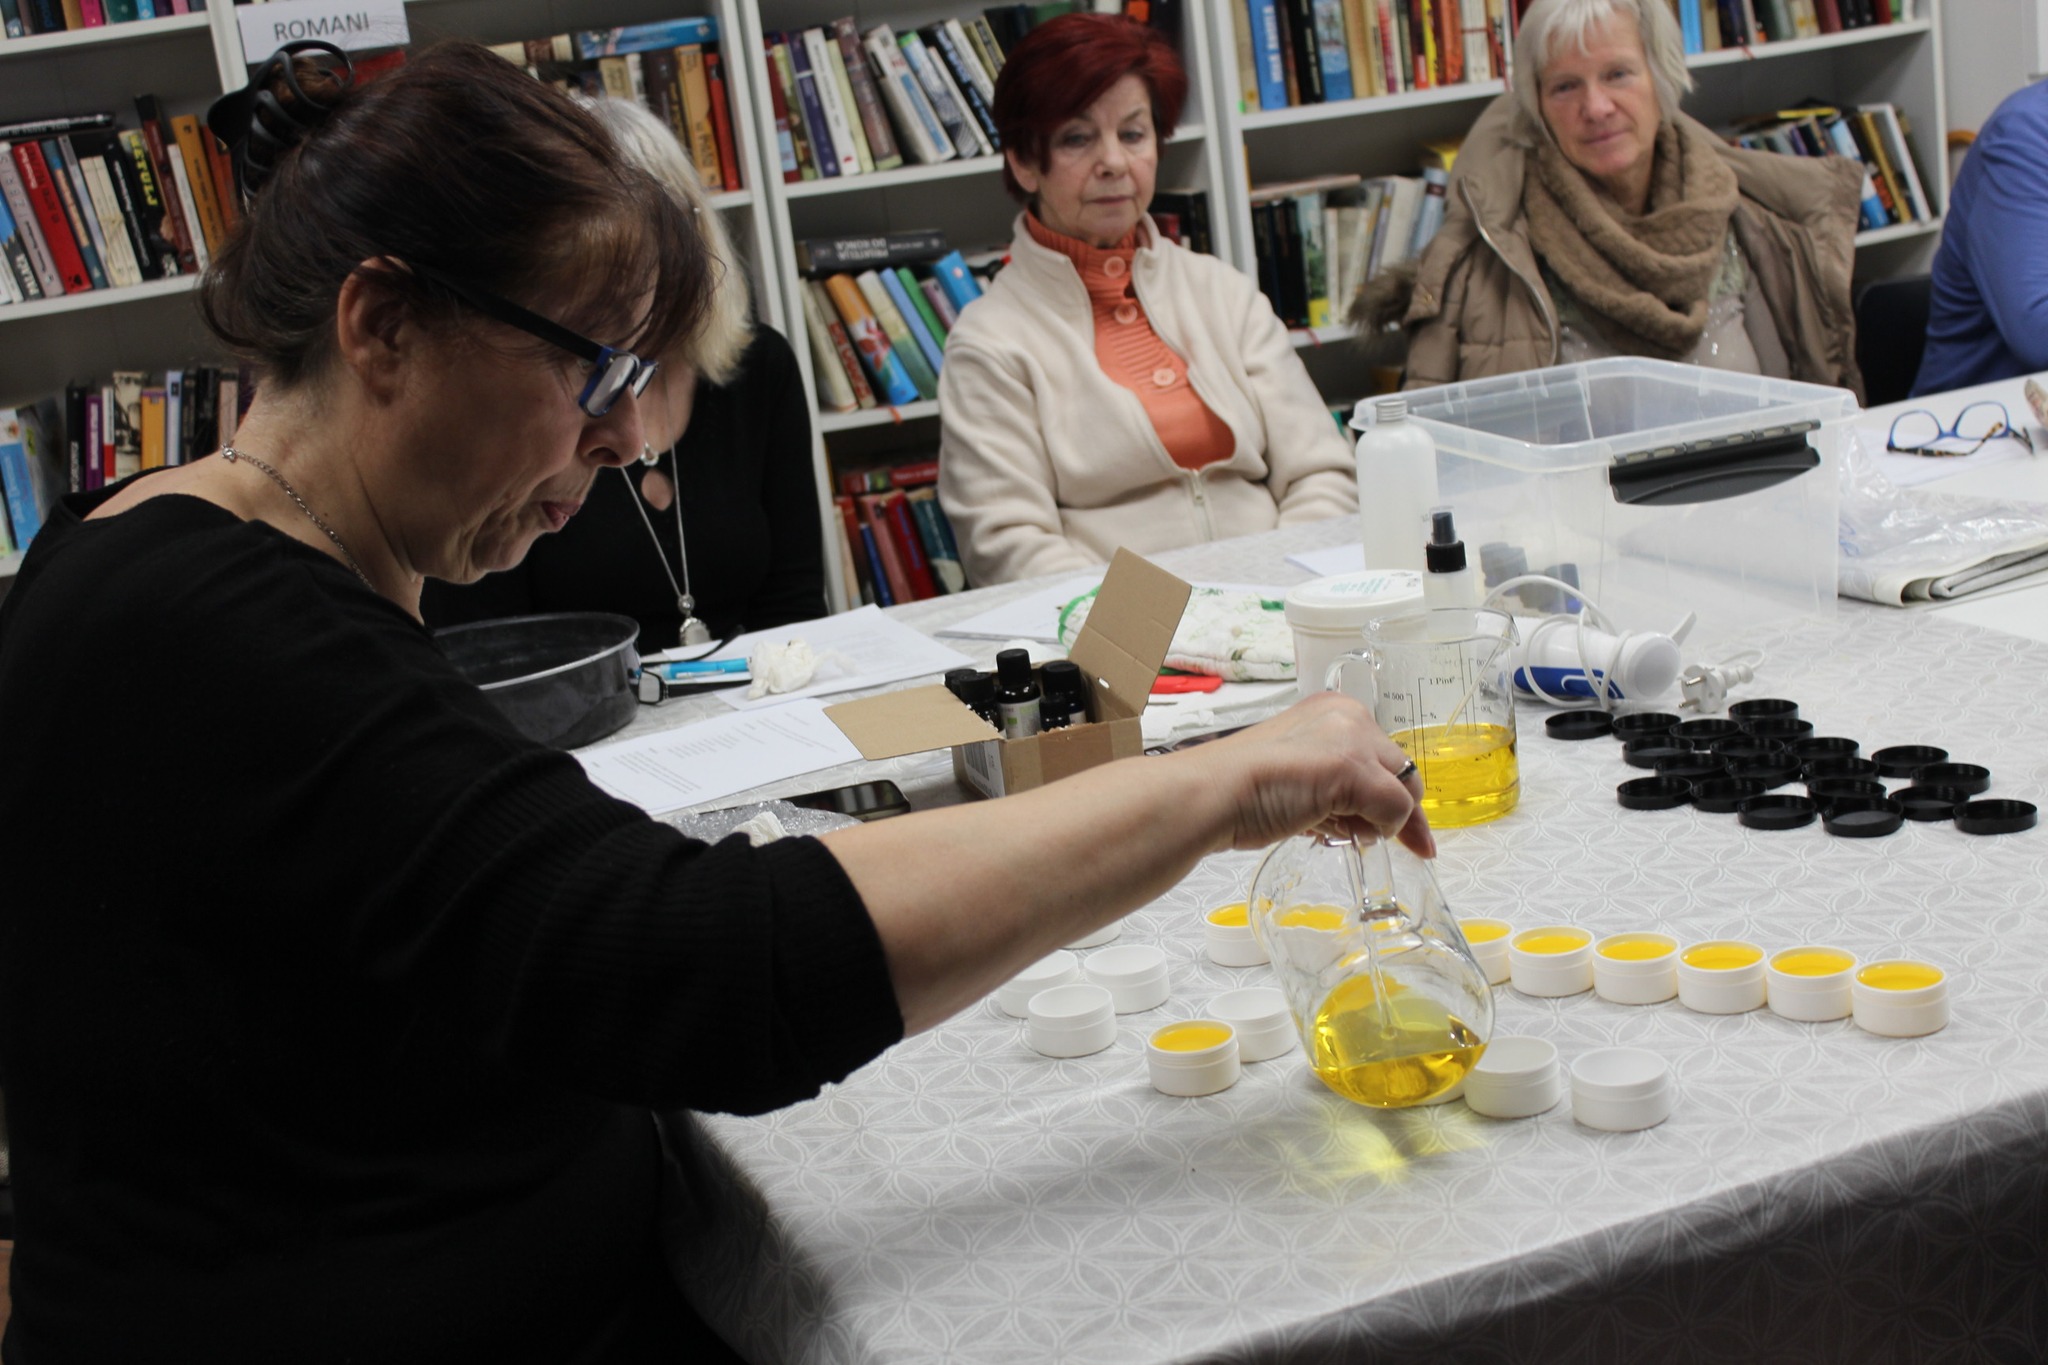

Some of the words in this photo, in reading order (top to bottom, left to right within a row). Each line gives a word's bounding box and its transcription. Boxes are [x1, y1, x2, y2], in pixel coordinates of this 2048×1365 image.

[273, 12, 370, 41] ROMANI
[127, 134, 158, 206] METULJ
[1392, 692, 1404, 701] 500
[1394, 715, 1406, 723] 400
